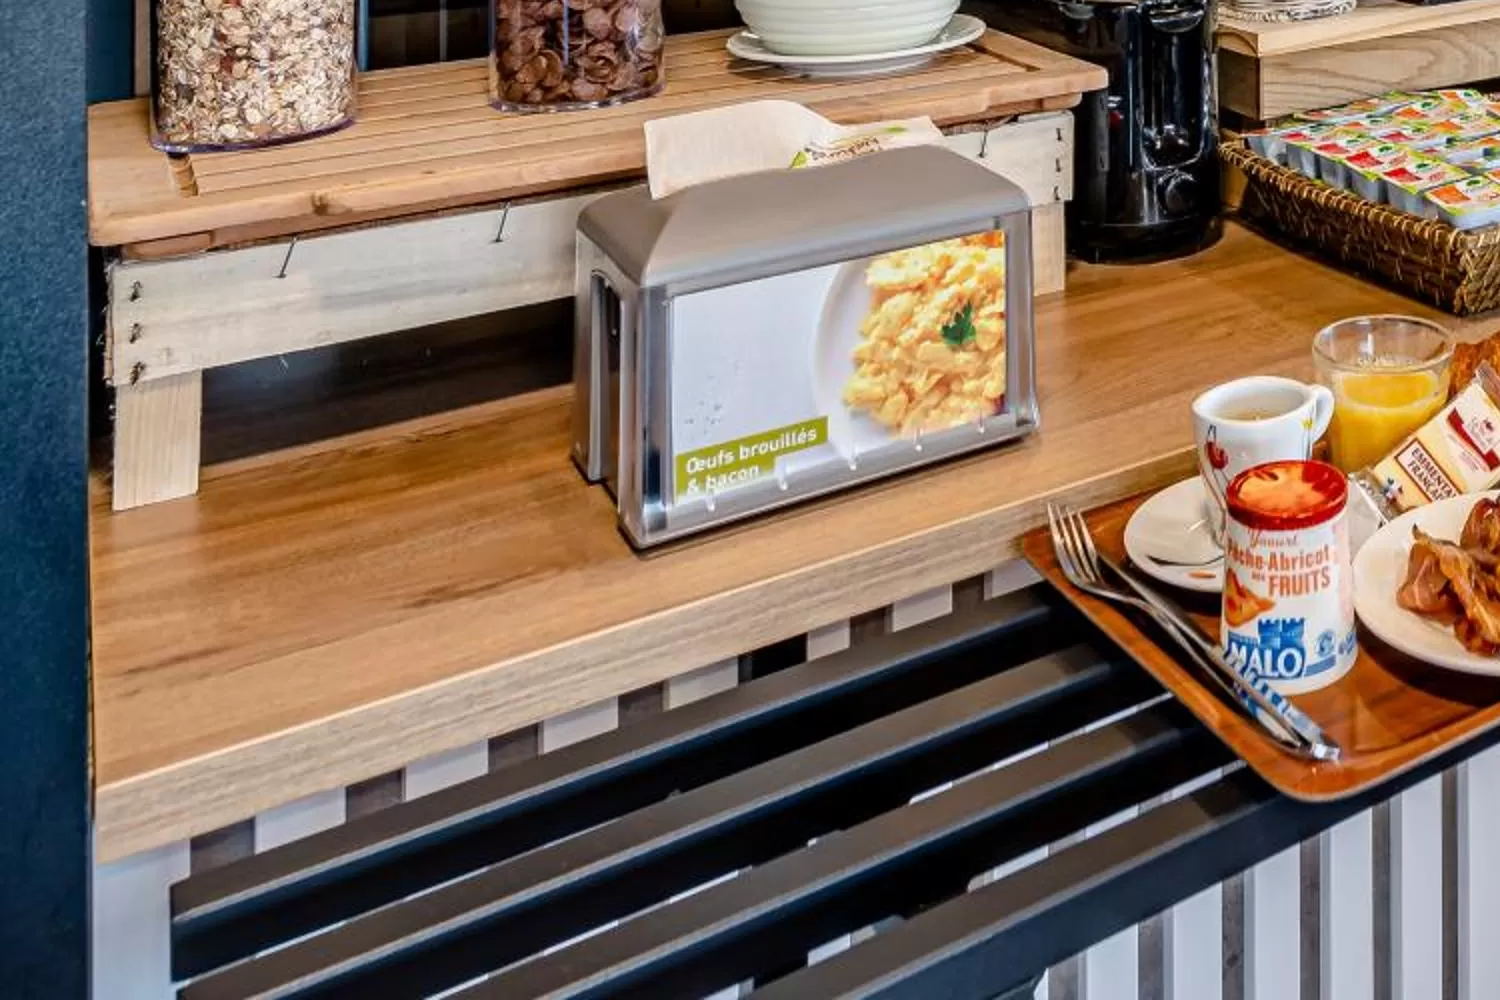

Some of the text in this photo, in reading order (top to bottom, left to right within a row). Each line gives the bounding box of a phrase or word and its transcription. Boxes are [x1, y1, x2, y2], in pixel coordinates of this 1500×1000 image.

[685, 427, 817, 474] Œufs brouillés
[704, 465, 760, 494] bacon
[1268, 565, 1332, 597] FRUITS
[1224, 641, 1304, 679] MALO
